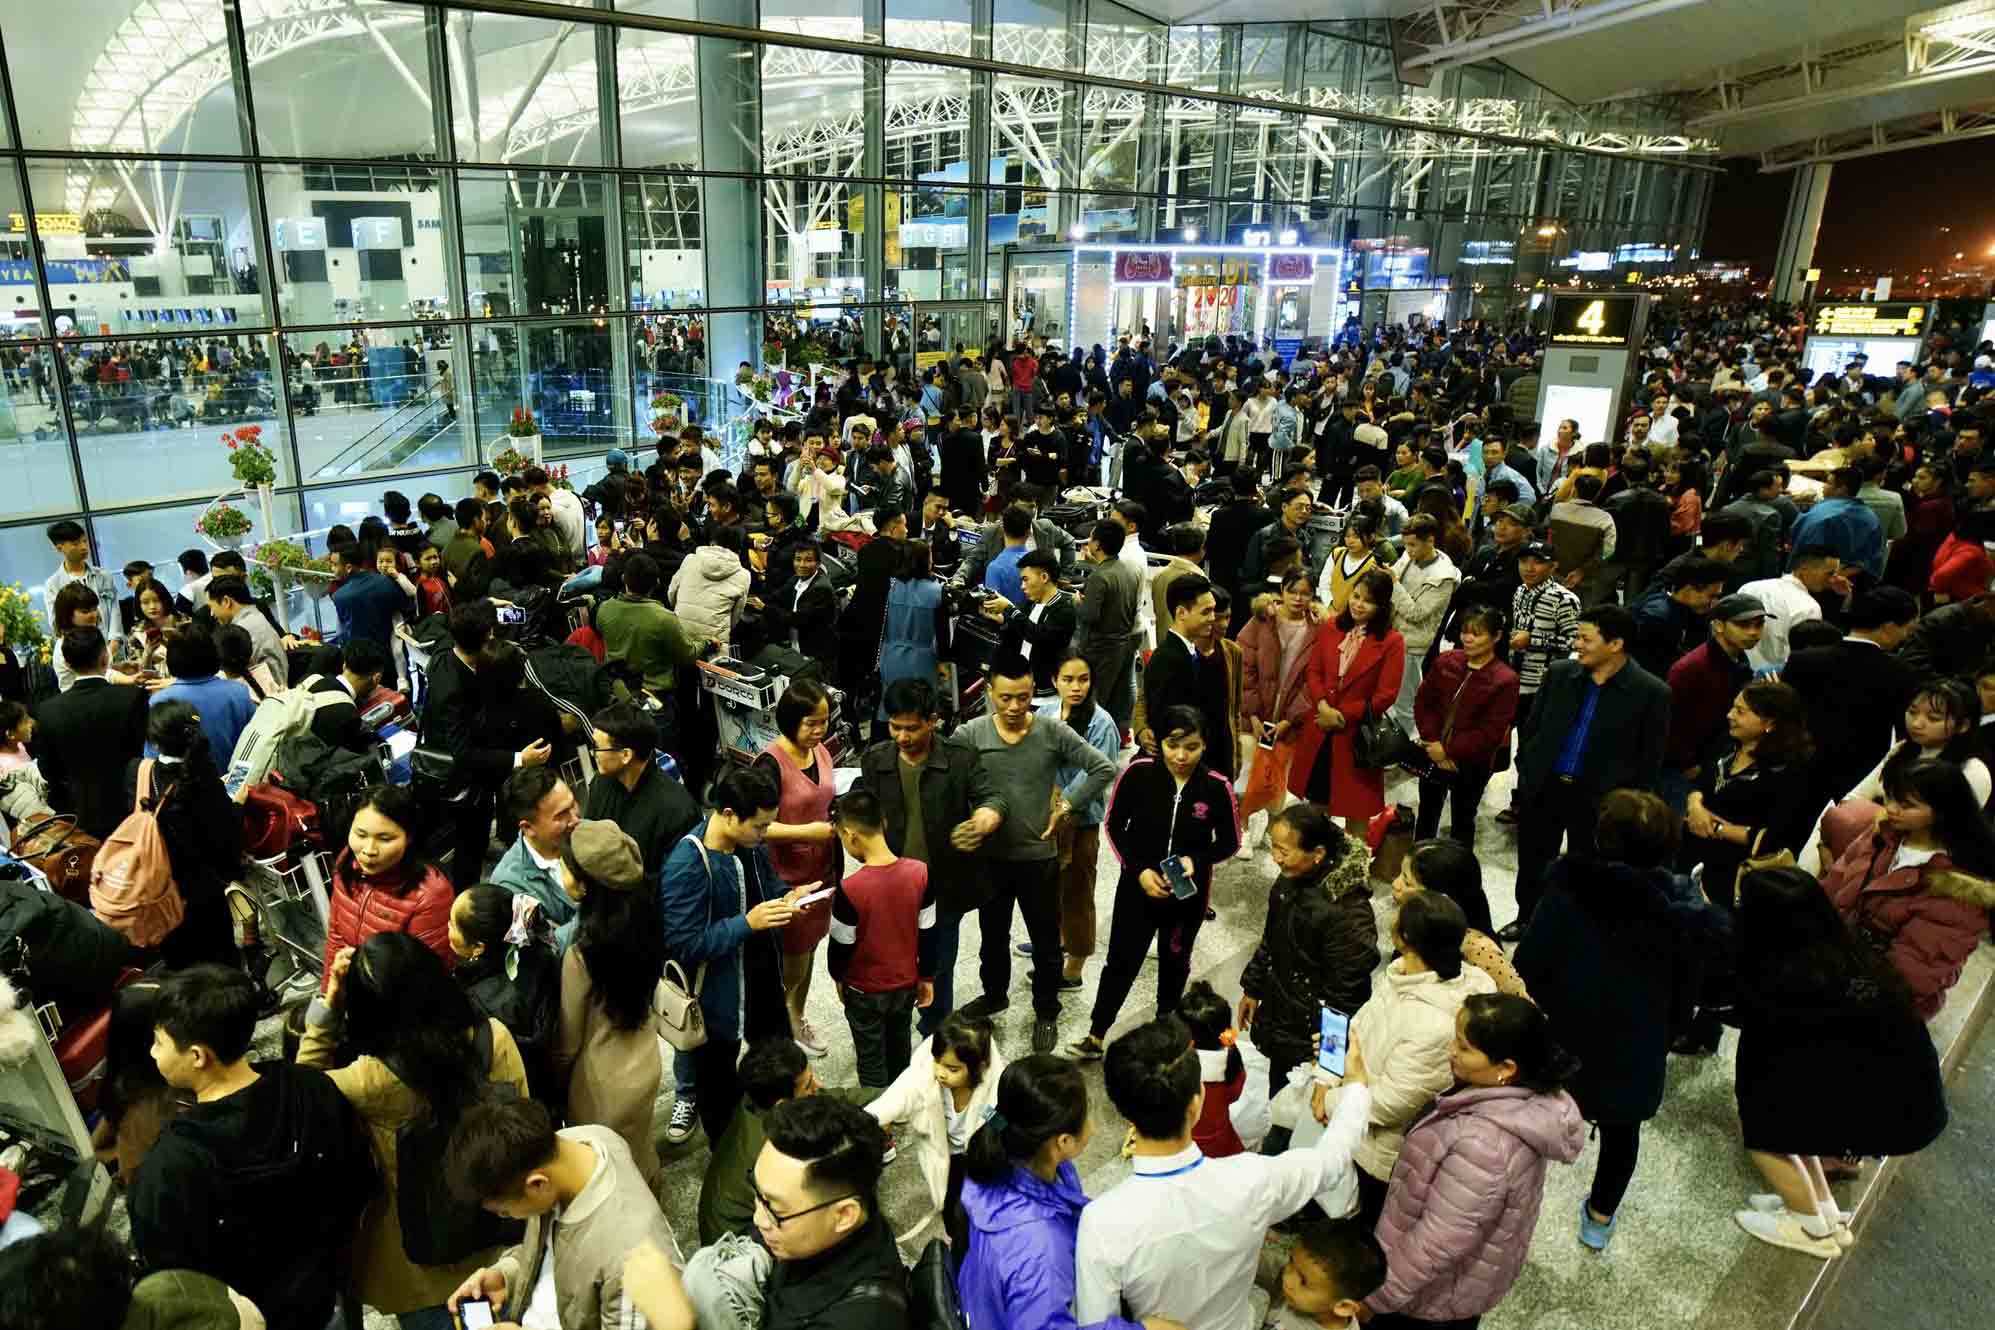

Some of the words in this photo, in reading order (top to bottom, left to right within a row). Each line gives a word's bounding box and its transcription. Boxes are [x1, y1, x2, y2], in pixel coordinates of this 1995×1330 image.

[297, 222, 317, 244] E
[375, 223, 390, 243] F
[1575, 299, 1605, 335] 4
